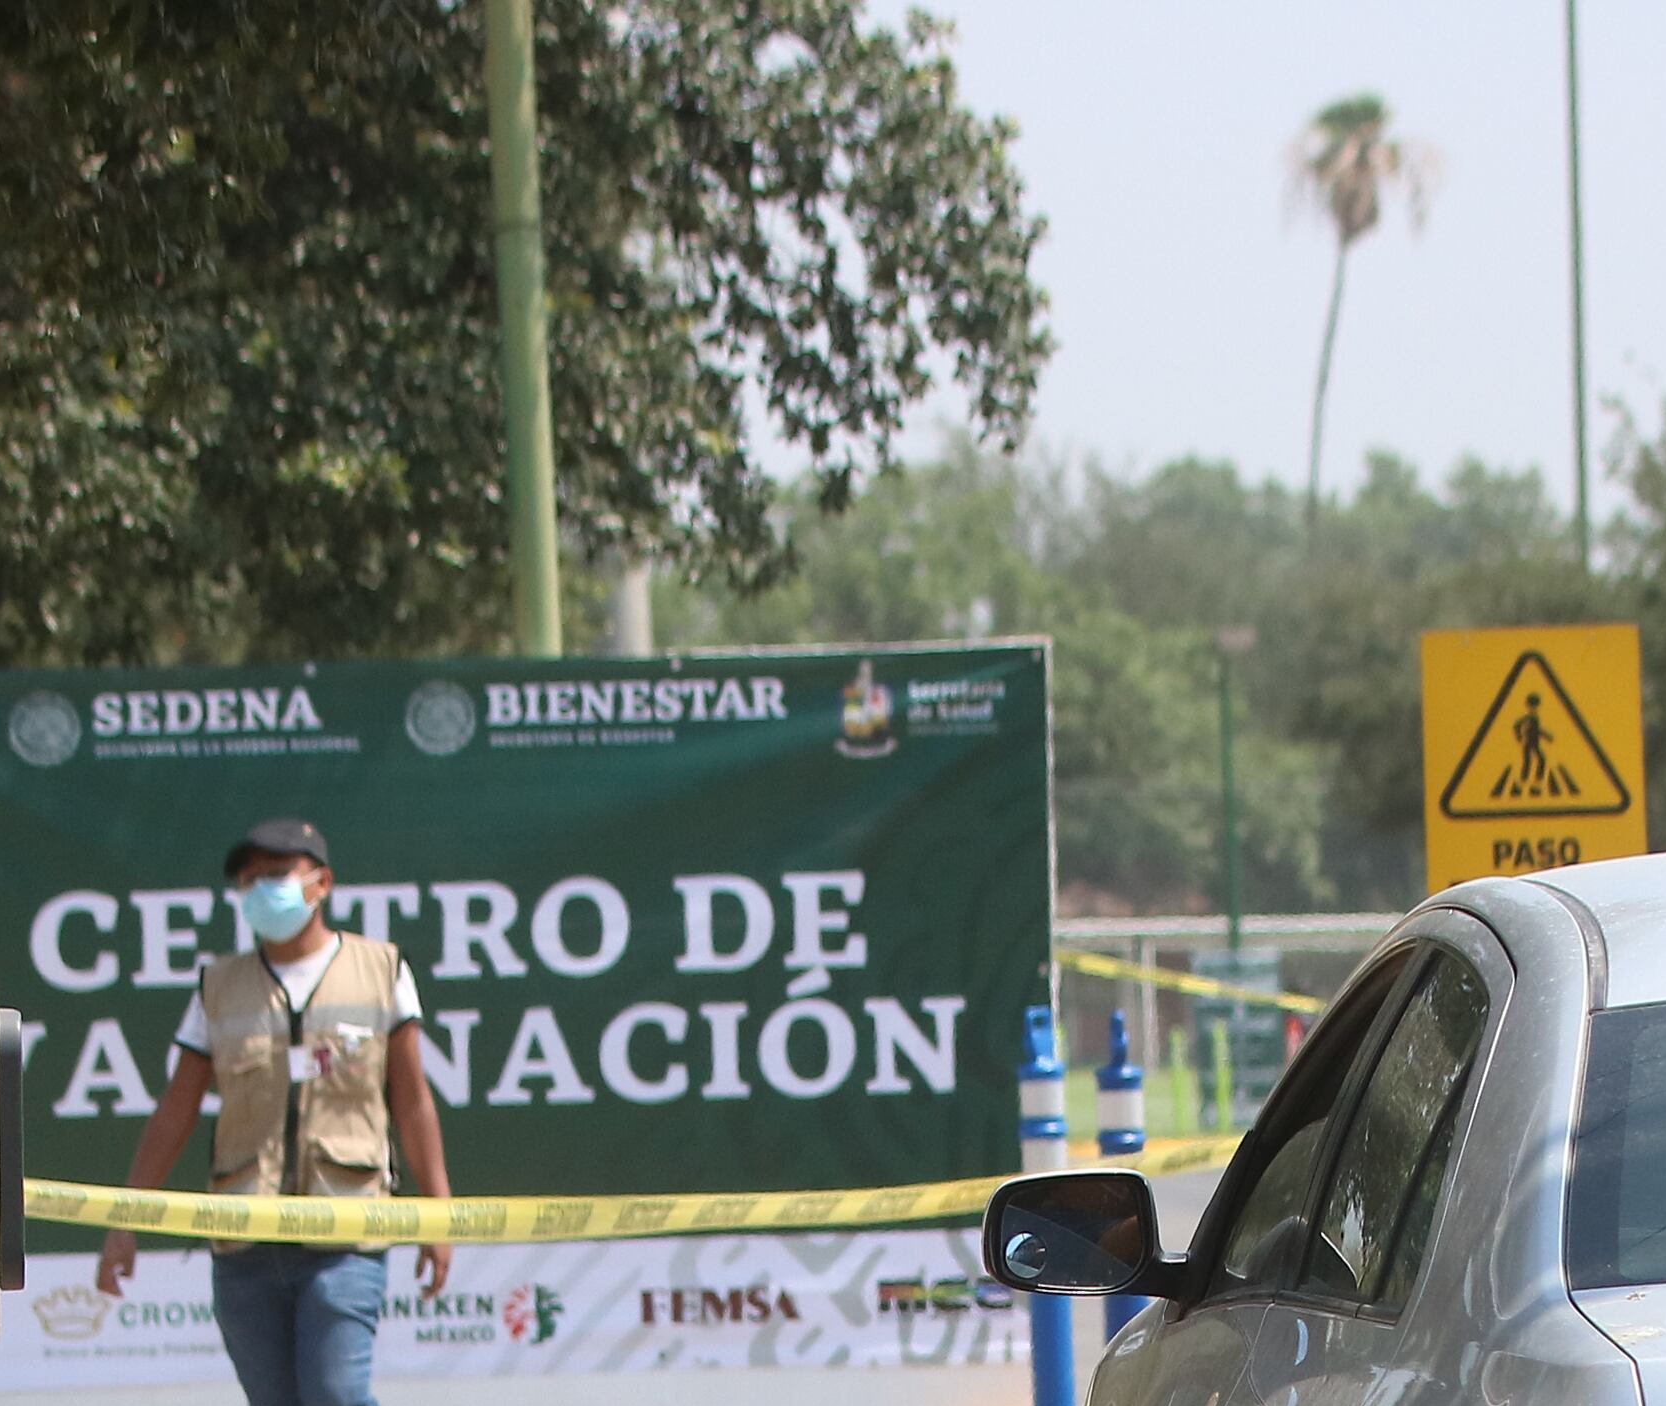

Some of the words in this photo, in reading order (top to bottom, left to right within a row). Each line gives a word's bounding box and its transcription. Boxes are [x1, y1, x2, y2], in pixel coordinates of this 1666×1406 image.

[91, 684, 324, 738] SEDENA
[485, 675, 788, 728] BIENESTAR
[1491, 835, 1582, 870] PASO
[673, 868, 868, 974] DE
[640, 1287, 802, 1324] FEMSA
